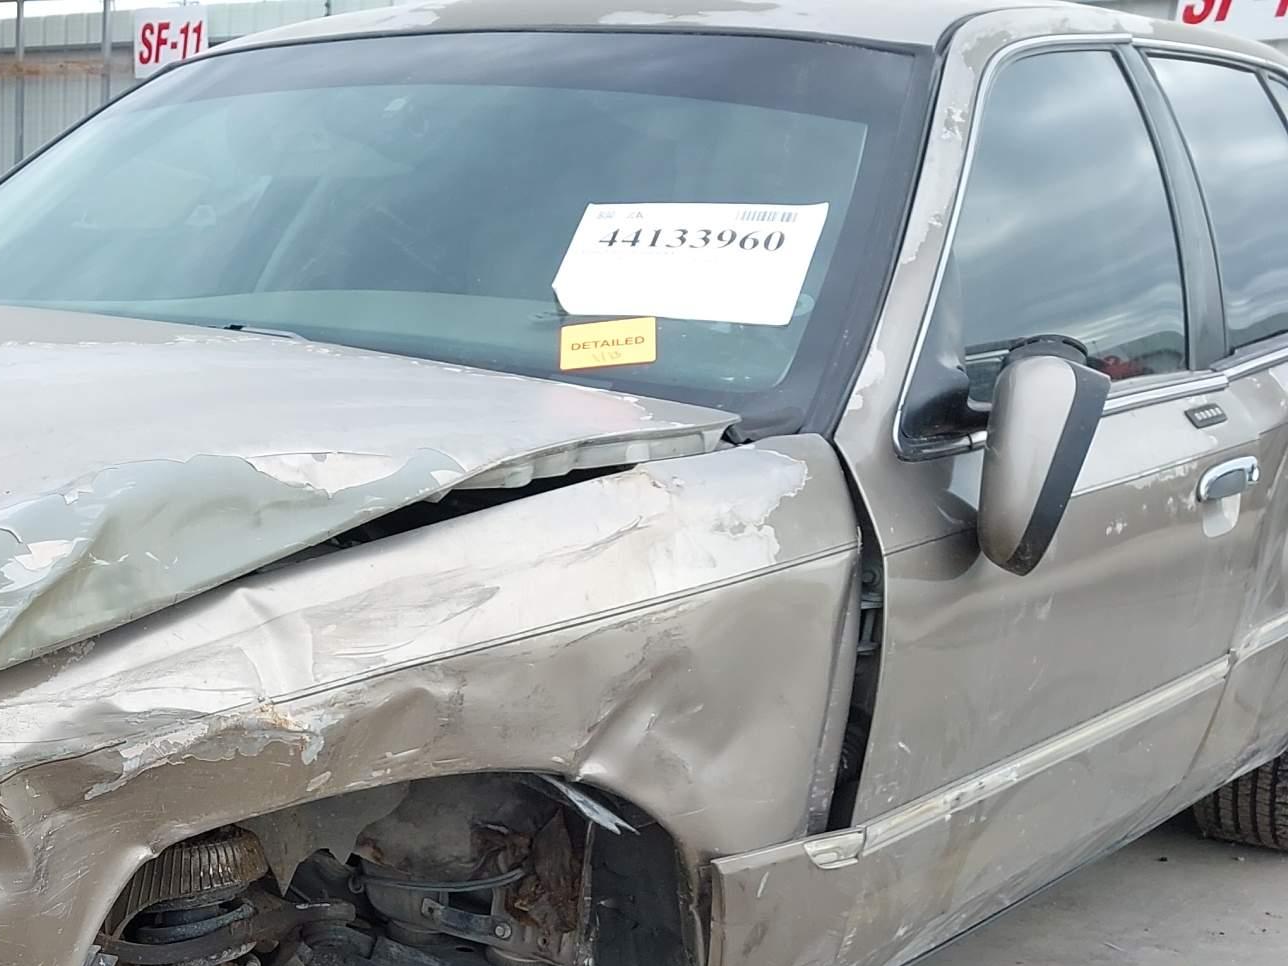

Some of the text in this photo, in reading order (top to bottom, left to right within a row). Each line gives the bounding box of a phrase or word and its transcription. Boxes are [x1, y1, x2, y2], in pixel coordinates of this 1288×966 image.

[139, 20, 202, 64] SF-11
[598, 228, 786, 251] 44133960
[571, 335, 645, 351] DETAILED
